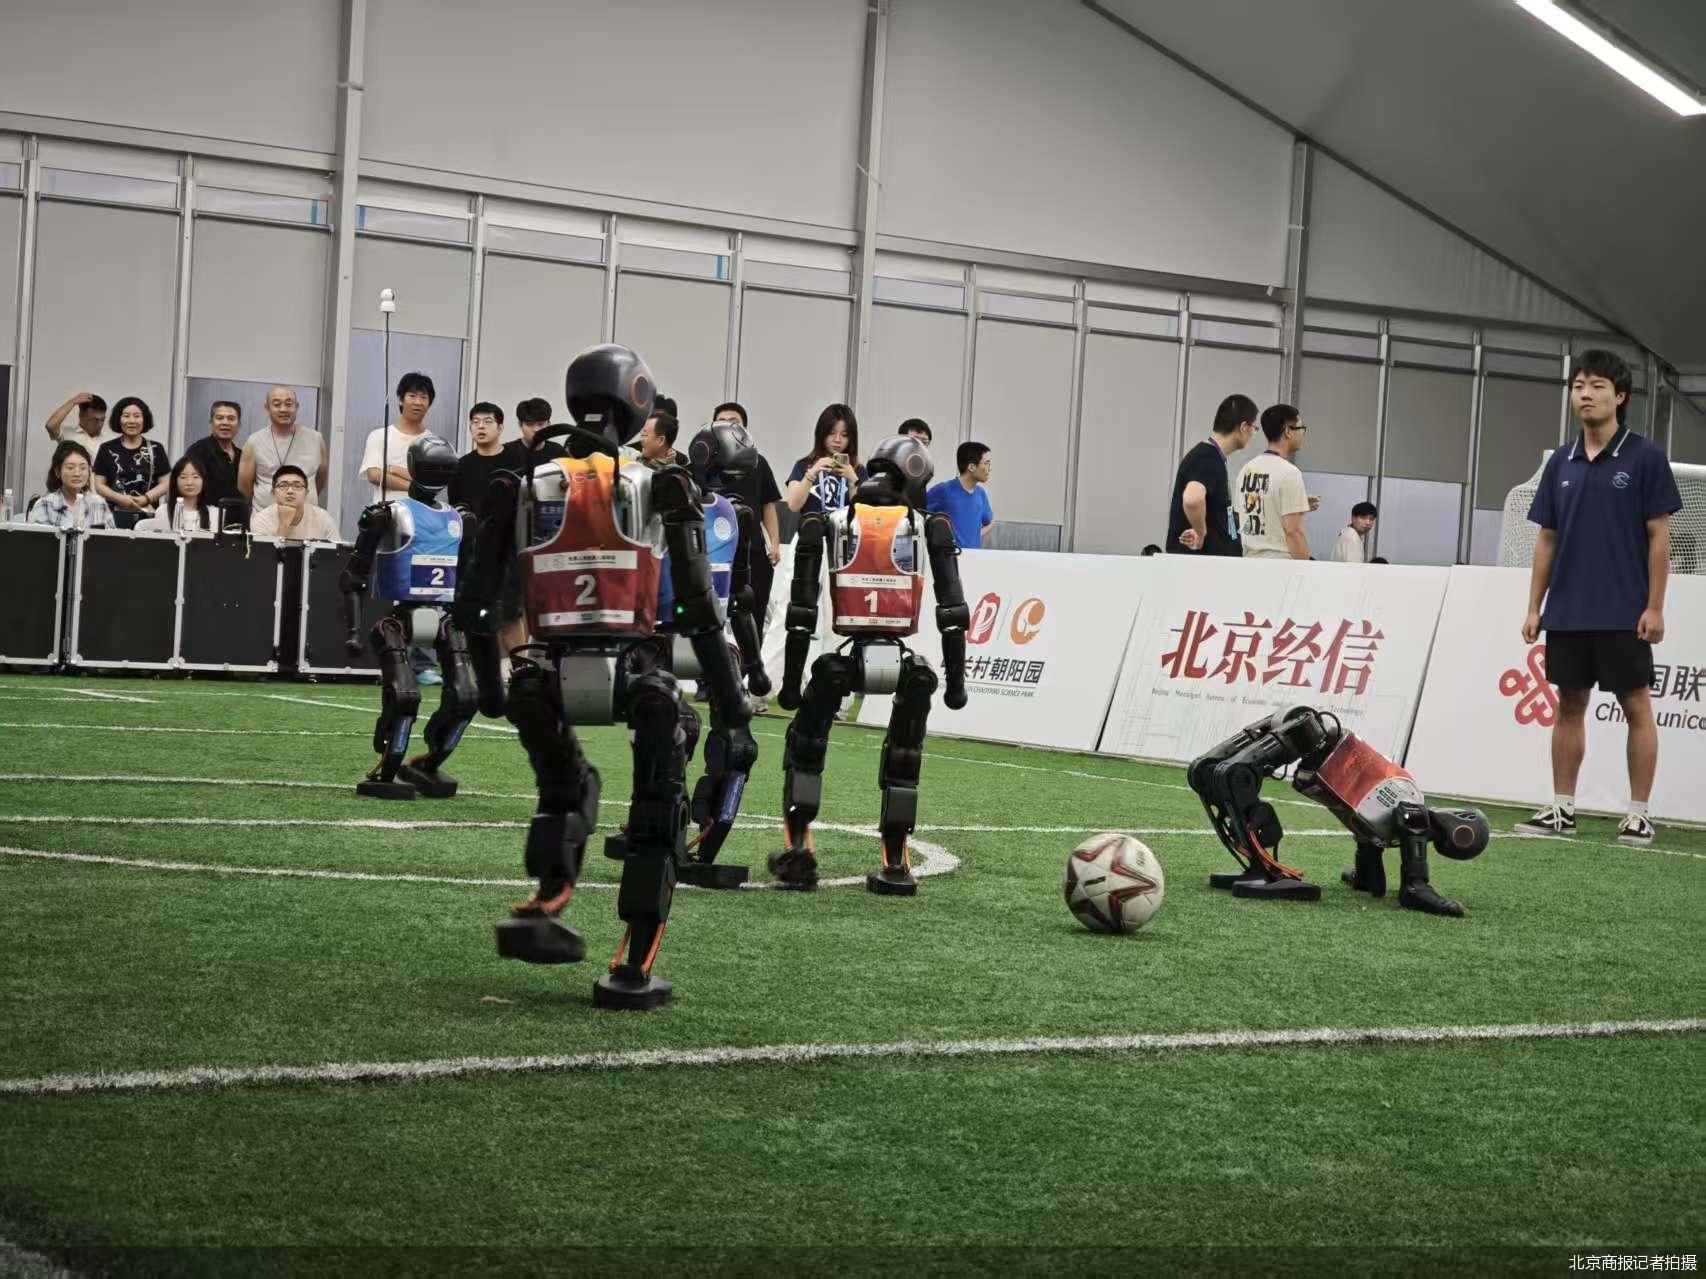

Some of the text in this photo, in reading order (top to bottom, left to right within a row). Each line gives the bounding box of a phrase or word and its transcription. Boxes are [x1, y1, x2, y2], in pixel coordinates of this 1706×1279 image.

[431, 567, 445, 586] 2
[574, 574, 597, 606] 2
[864, 590, 878, 613] 1
[1161, 610, 1385, 696] 北京经信
